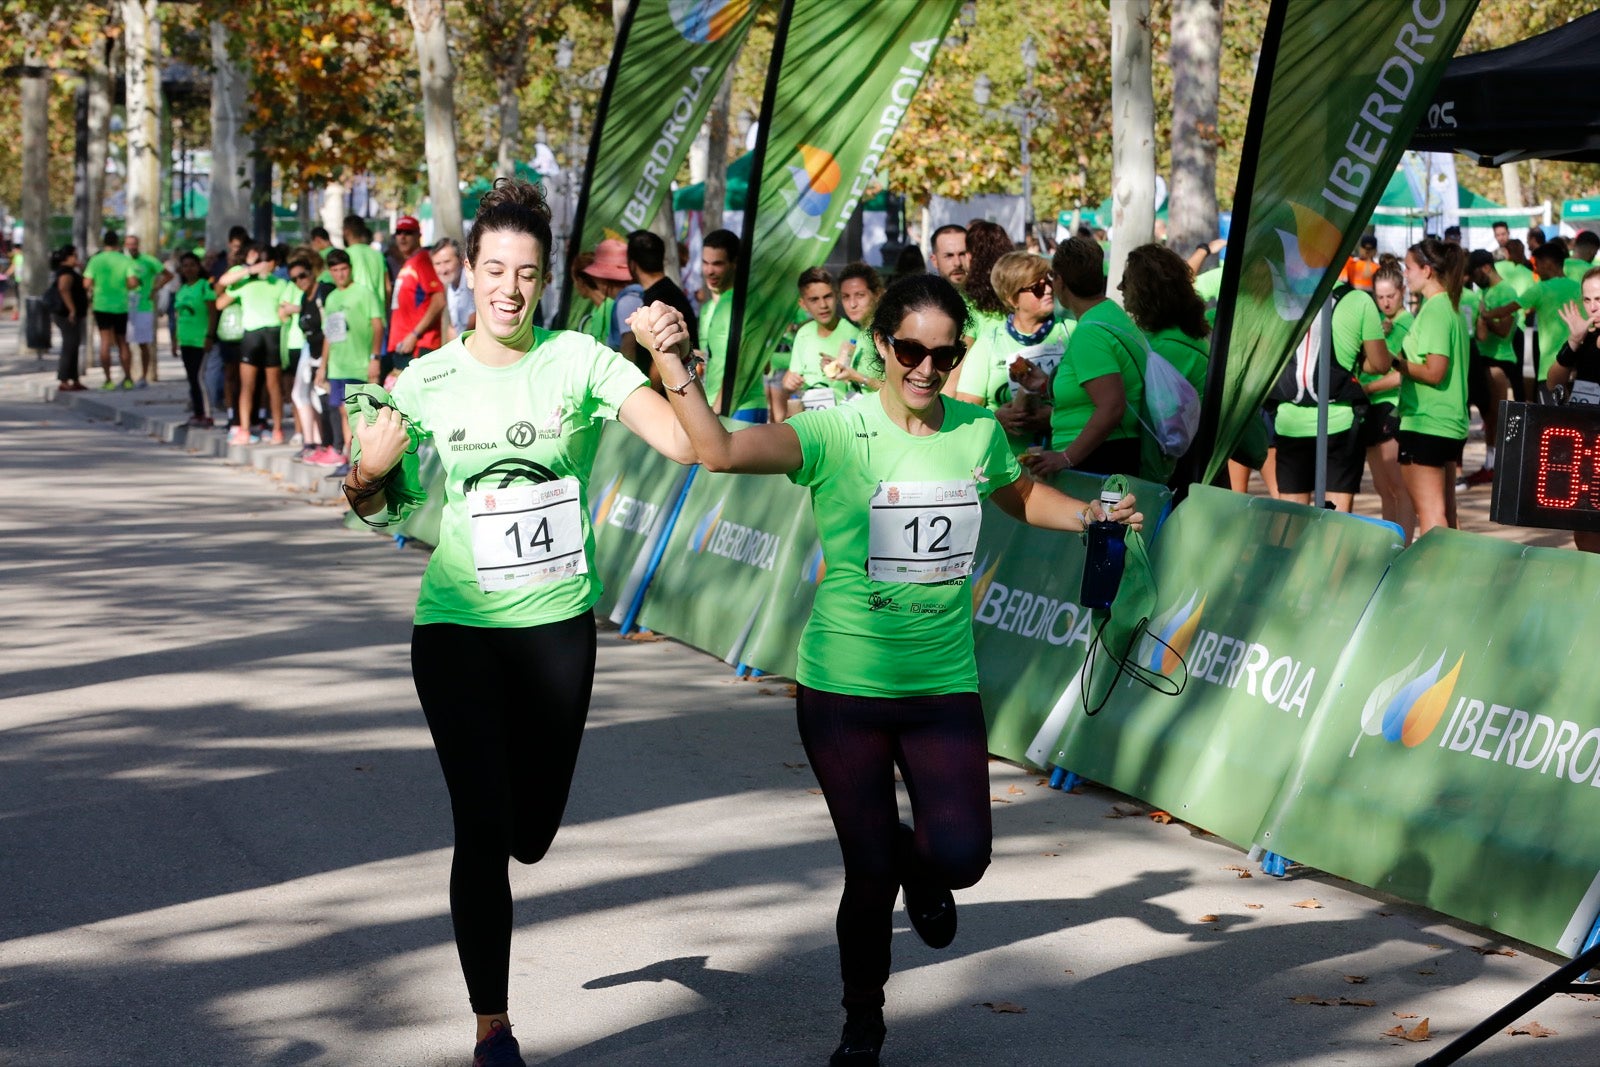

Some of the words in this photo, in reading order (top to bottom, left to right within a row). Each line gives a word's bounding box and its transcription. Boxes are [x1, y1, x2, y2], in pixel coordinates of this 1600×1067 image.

[620, 65, 712, 233] IBERDROLA
[451, 442, 498, 452] IBERDROLA
[505, 516, 554, 558] 14
[707, 519, 781, 571] IBERDROLA
[904, 515, 952, 553] 12
